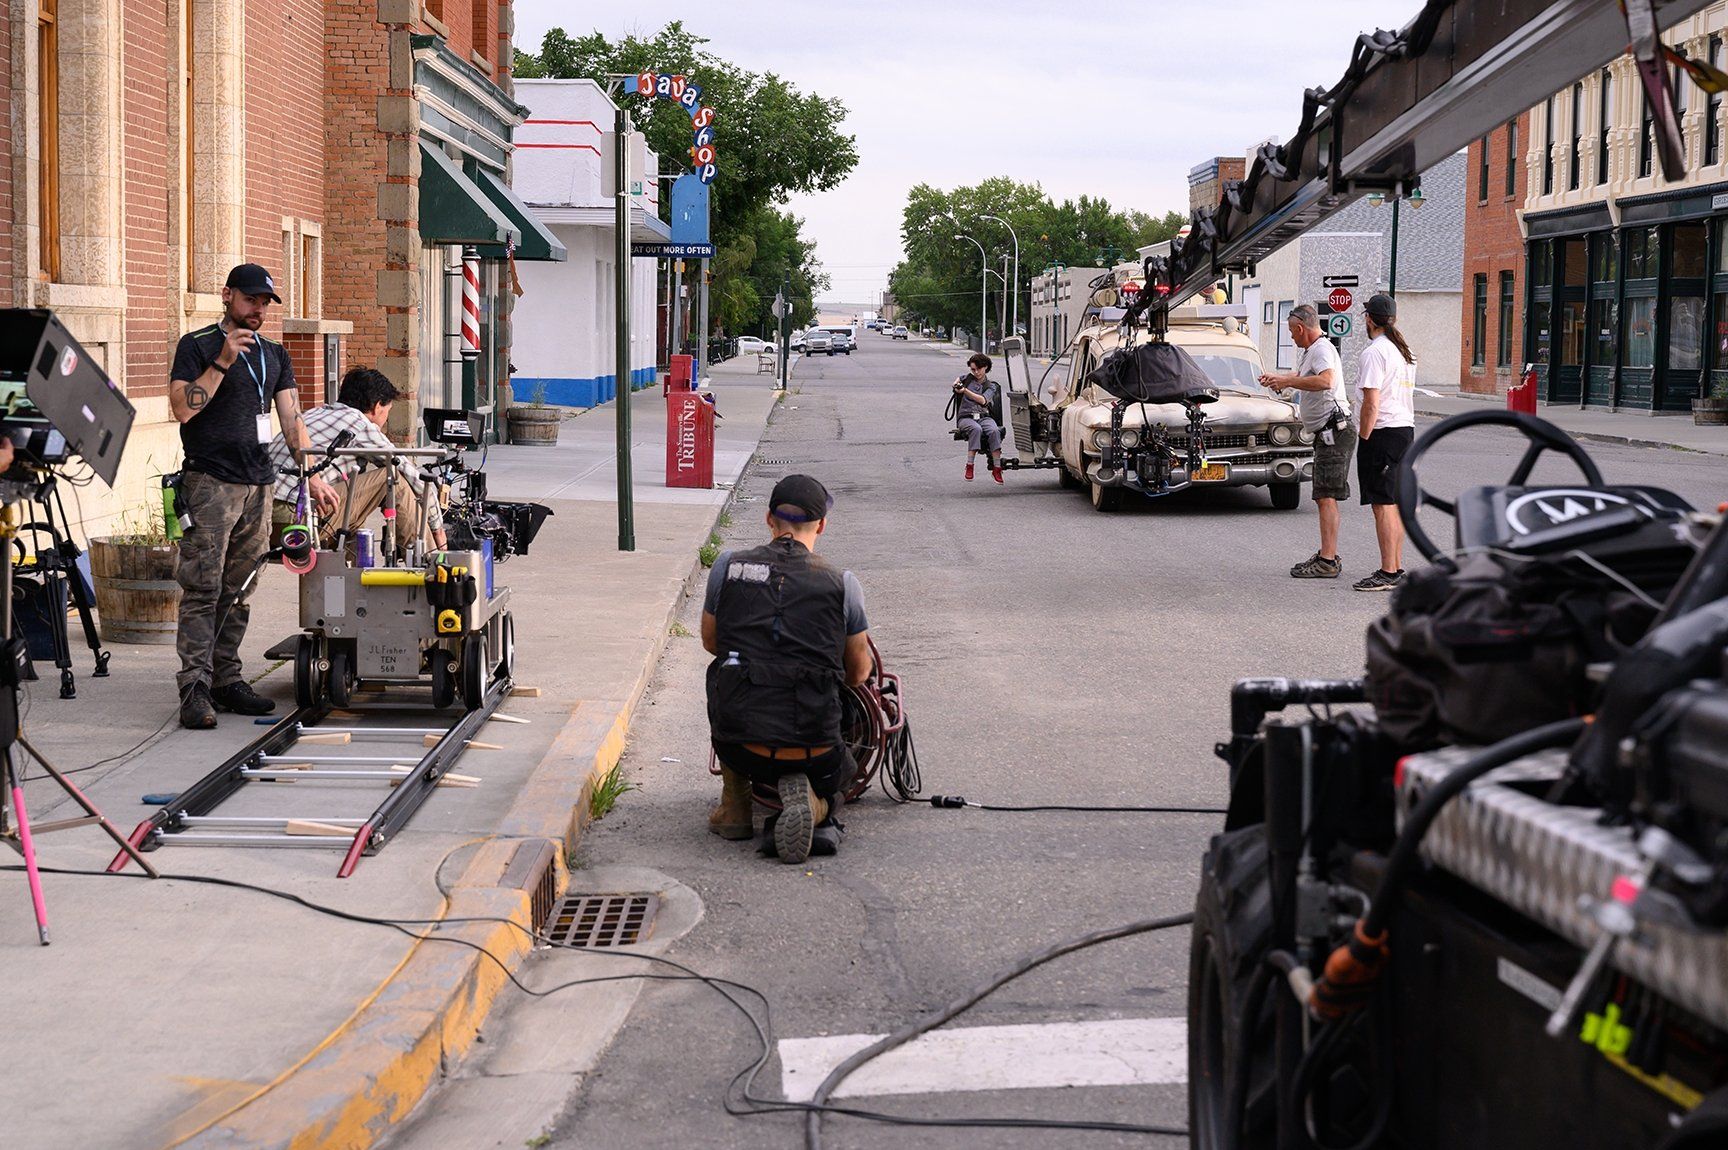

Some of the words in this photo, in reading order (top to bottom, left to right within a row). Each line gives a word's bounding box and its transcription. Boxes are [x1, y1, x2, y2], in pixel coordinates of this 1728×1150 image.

[641, 72, 697, 106] Java
[694, 107, 716, 183] Shop
[645, 245, 661, 254] OUT
[663, 246, 685, 254] MORE
[687, 246, 711, 255] OFTEN
[1330, 295, 1351, 305] STOP
[678, 399, 696, 472] TRIBUNE
[380, 665, 395, 673] 568
